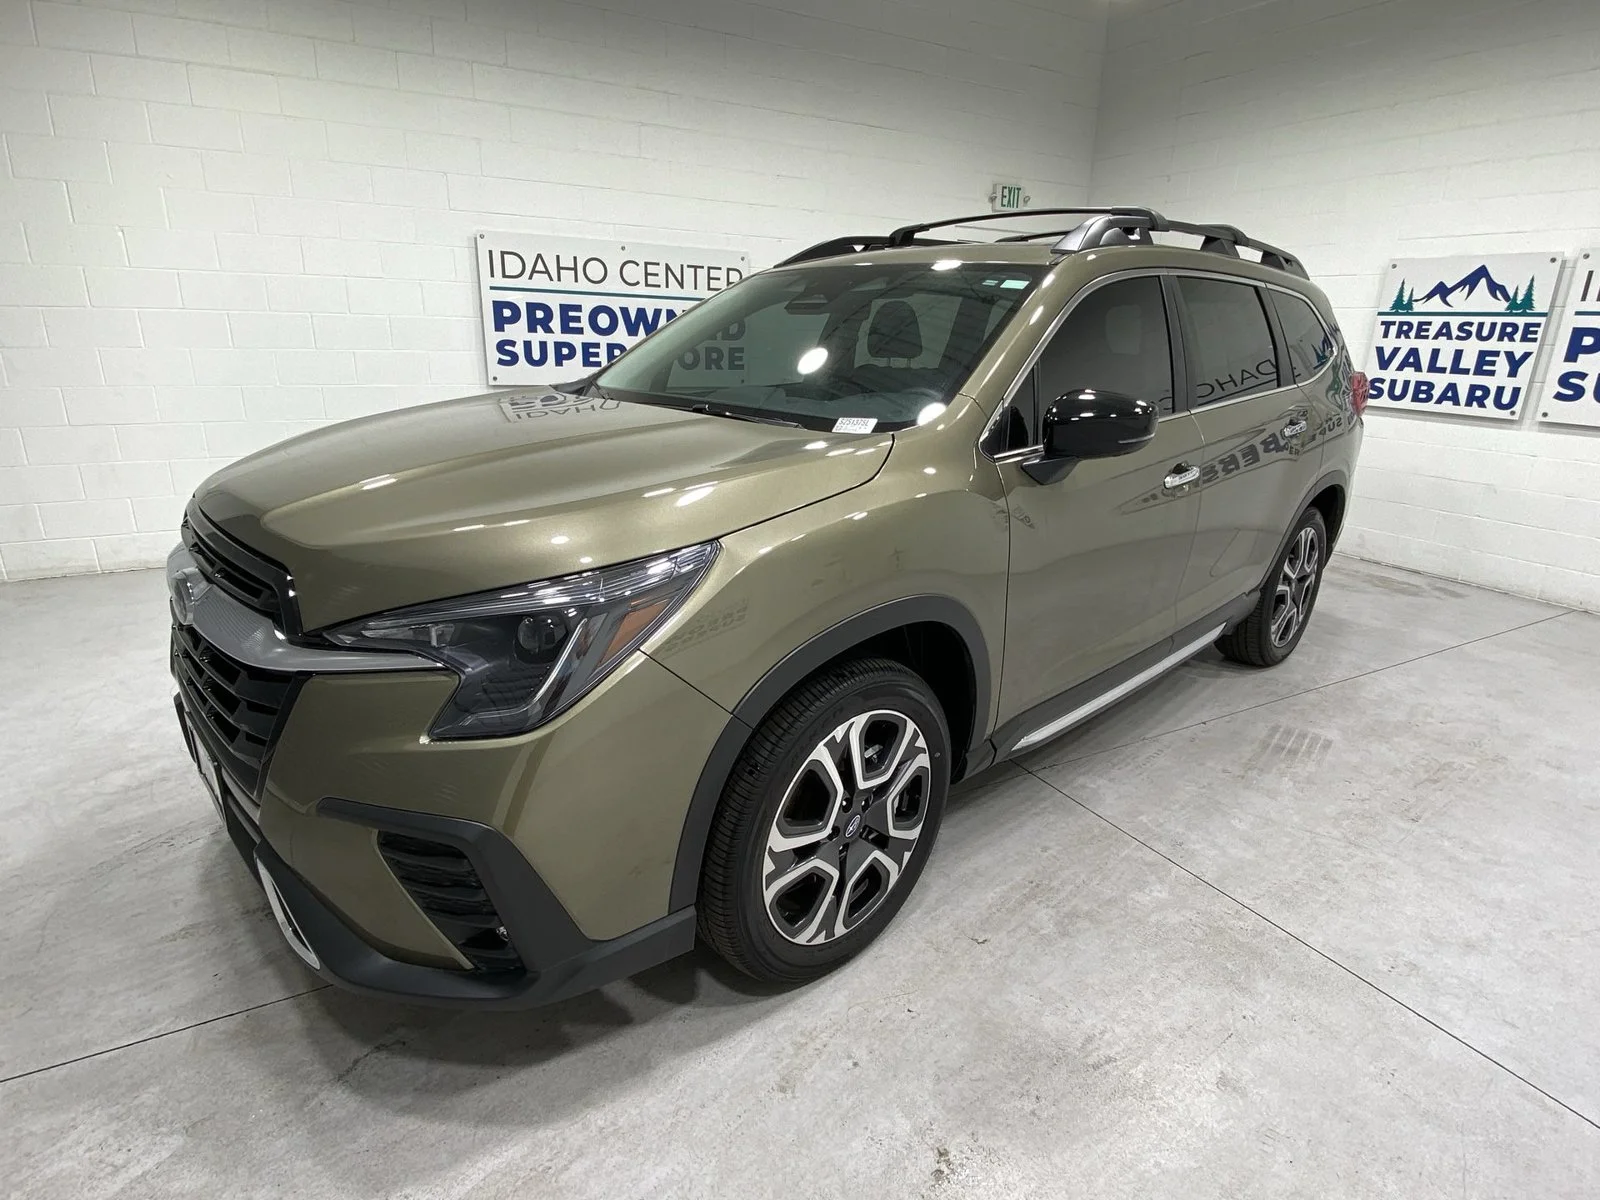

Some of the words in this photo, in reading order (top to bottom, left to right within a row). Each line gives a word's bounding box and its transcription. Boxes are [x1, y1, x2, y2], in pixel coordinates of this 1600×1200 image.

[1000, 186, 1022, 208] EXIT
[488, 249, 608, 285] IDAHO
[1380, 320, 1542, 343] TREASURE
[1375, 346, 1535, 378] VALLEY
[1368, 377, 1522, 411] SUBARU
[1552, 370, 1600, 404] S
